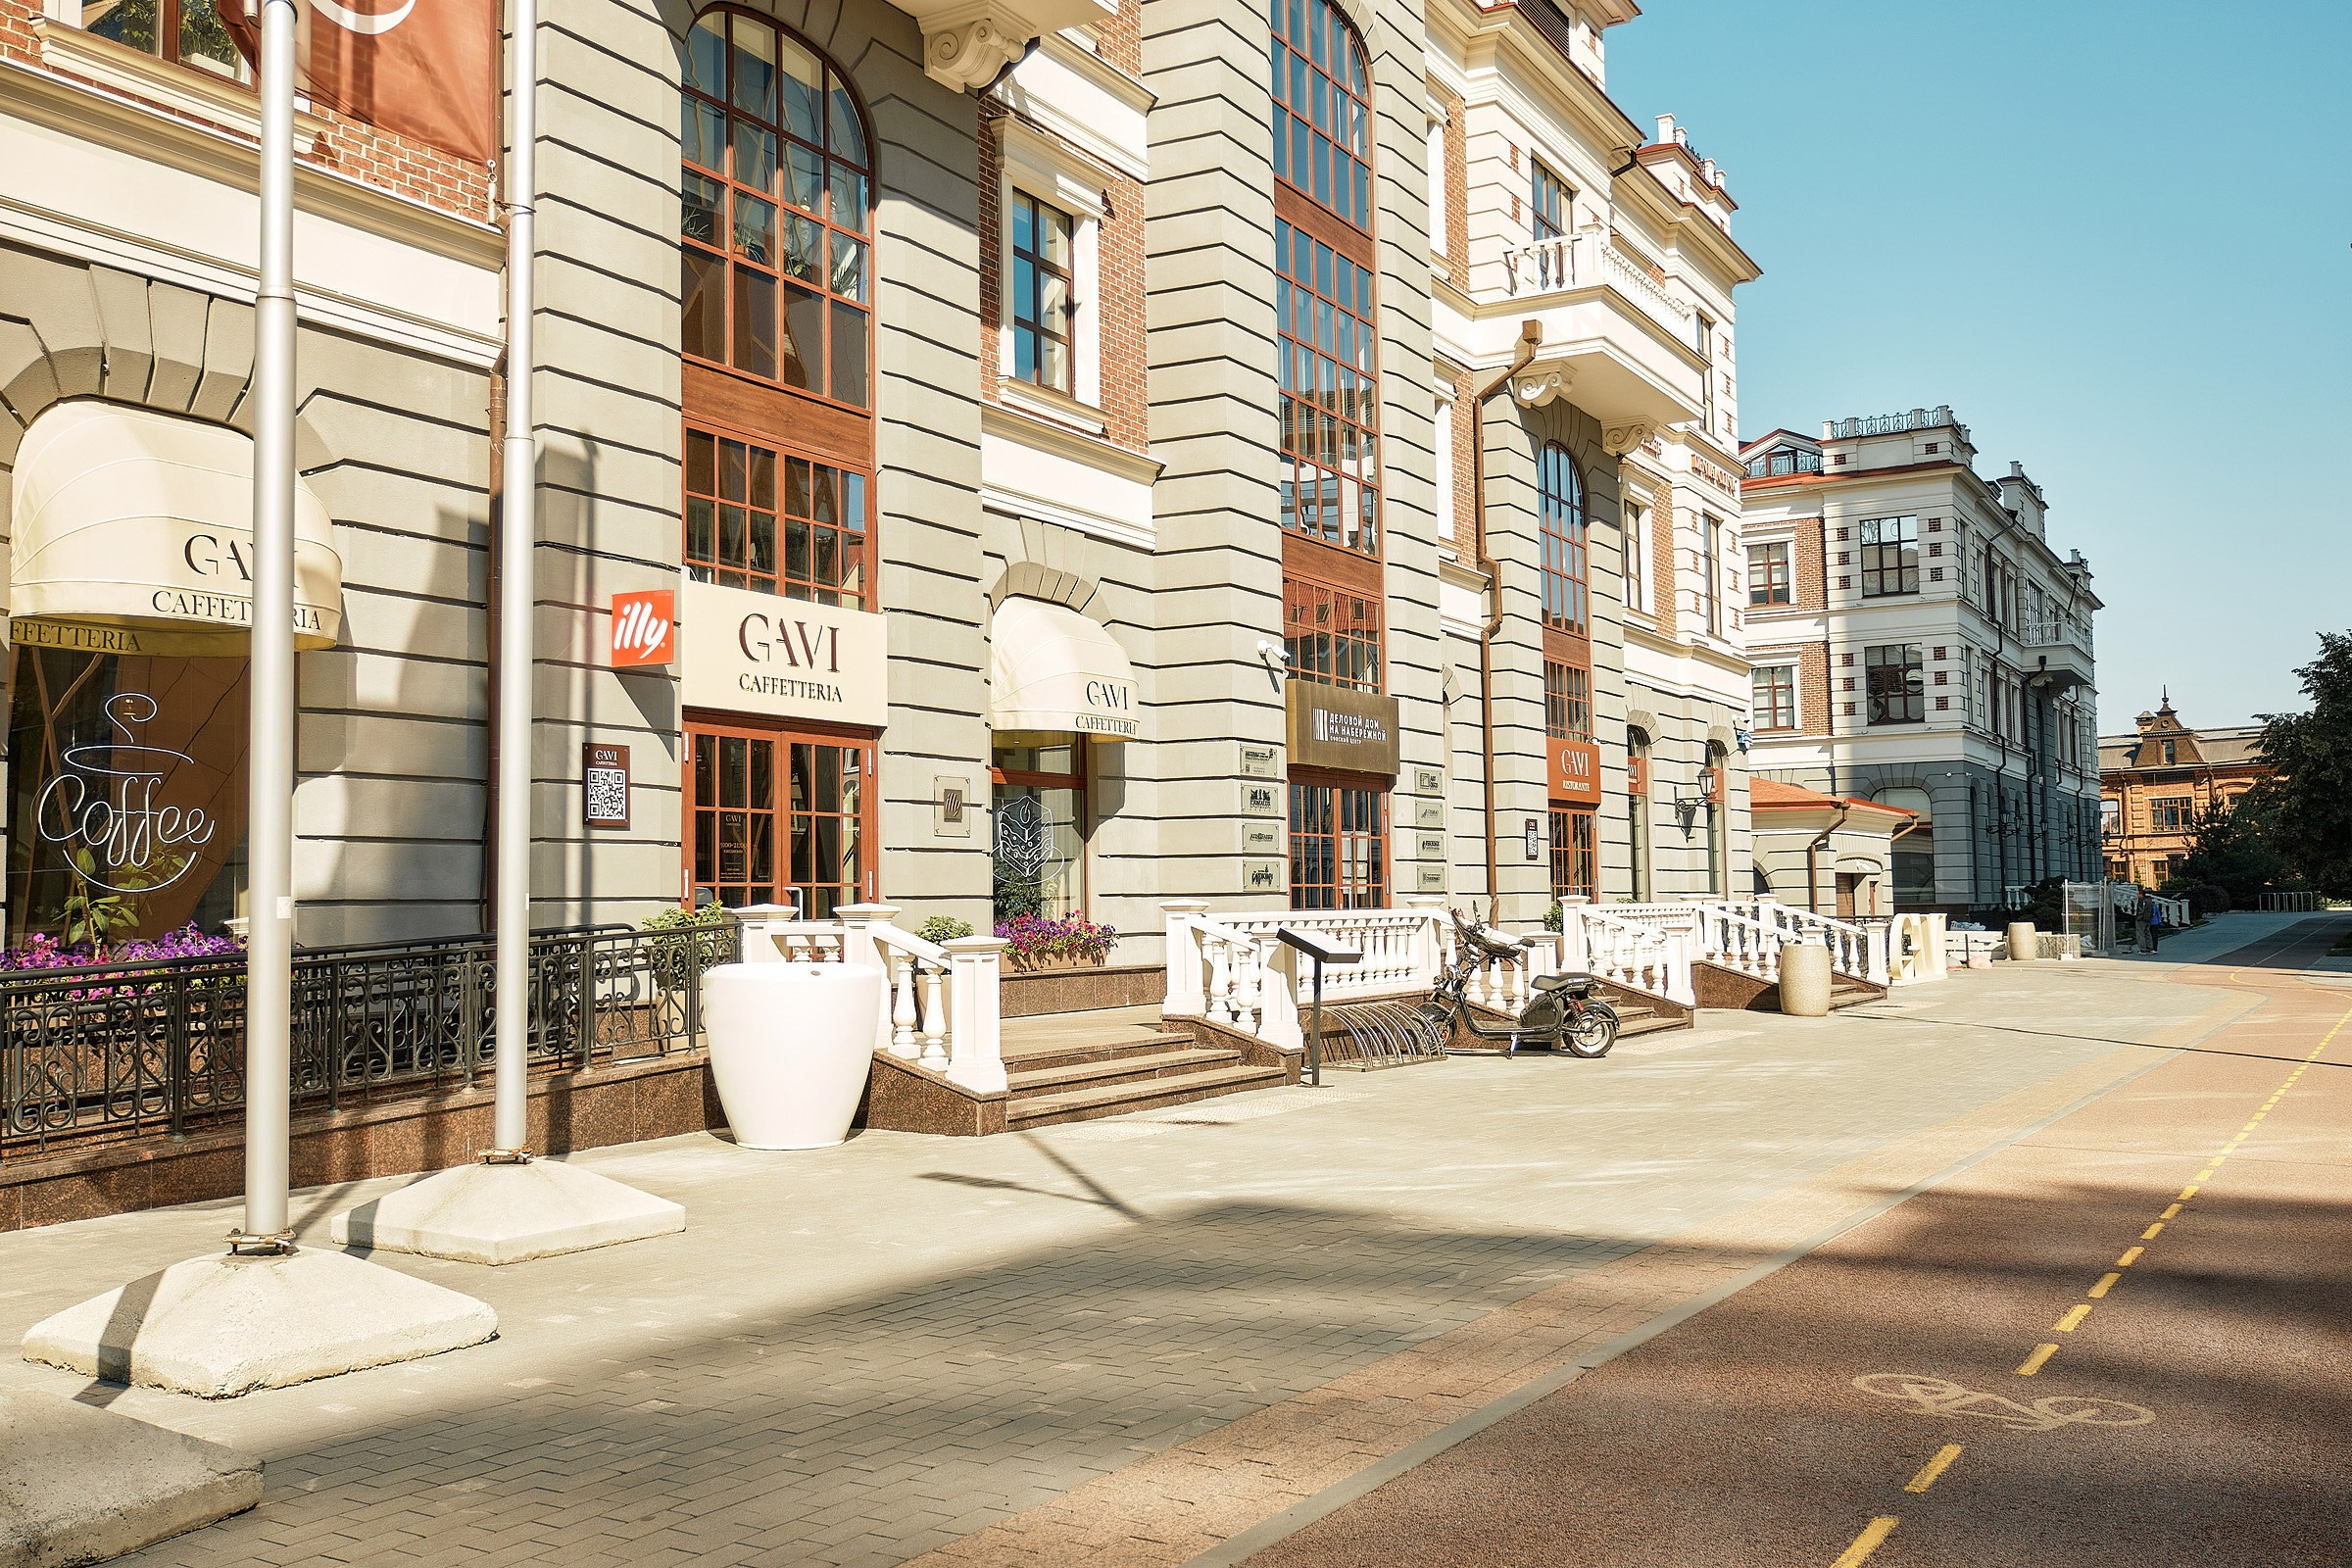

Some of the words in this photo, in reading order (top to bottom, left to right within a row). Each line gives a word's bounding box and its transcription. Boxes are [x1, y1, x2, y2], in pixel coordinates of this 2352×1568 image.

[613, 601, 669, 660] illy
[738, 612, 841, 674] GAVI
[738, 672, 843, 704] CAFFETTERIA
[1086, 680, 1129, 710] GAVI
[1329, 713, 1363, 727] ДЕЛОВОЙ
[1364, 718, 1380, 730] ДОМ
[1329, 724, 1340, 735] НА
[1341, 726, 1386, 741] НАБЕРЕЖНОЙ
[595, 750, 618, 760] GAVI
[1561, 749, 1590, 777] GAVI
[945, 792, 961, 817] illy
[37, 774, 215, 866] Coffee
